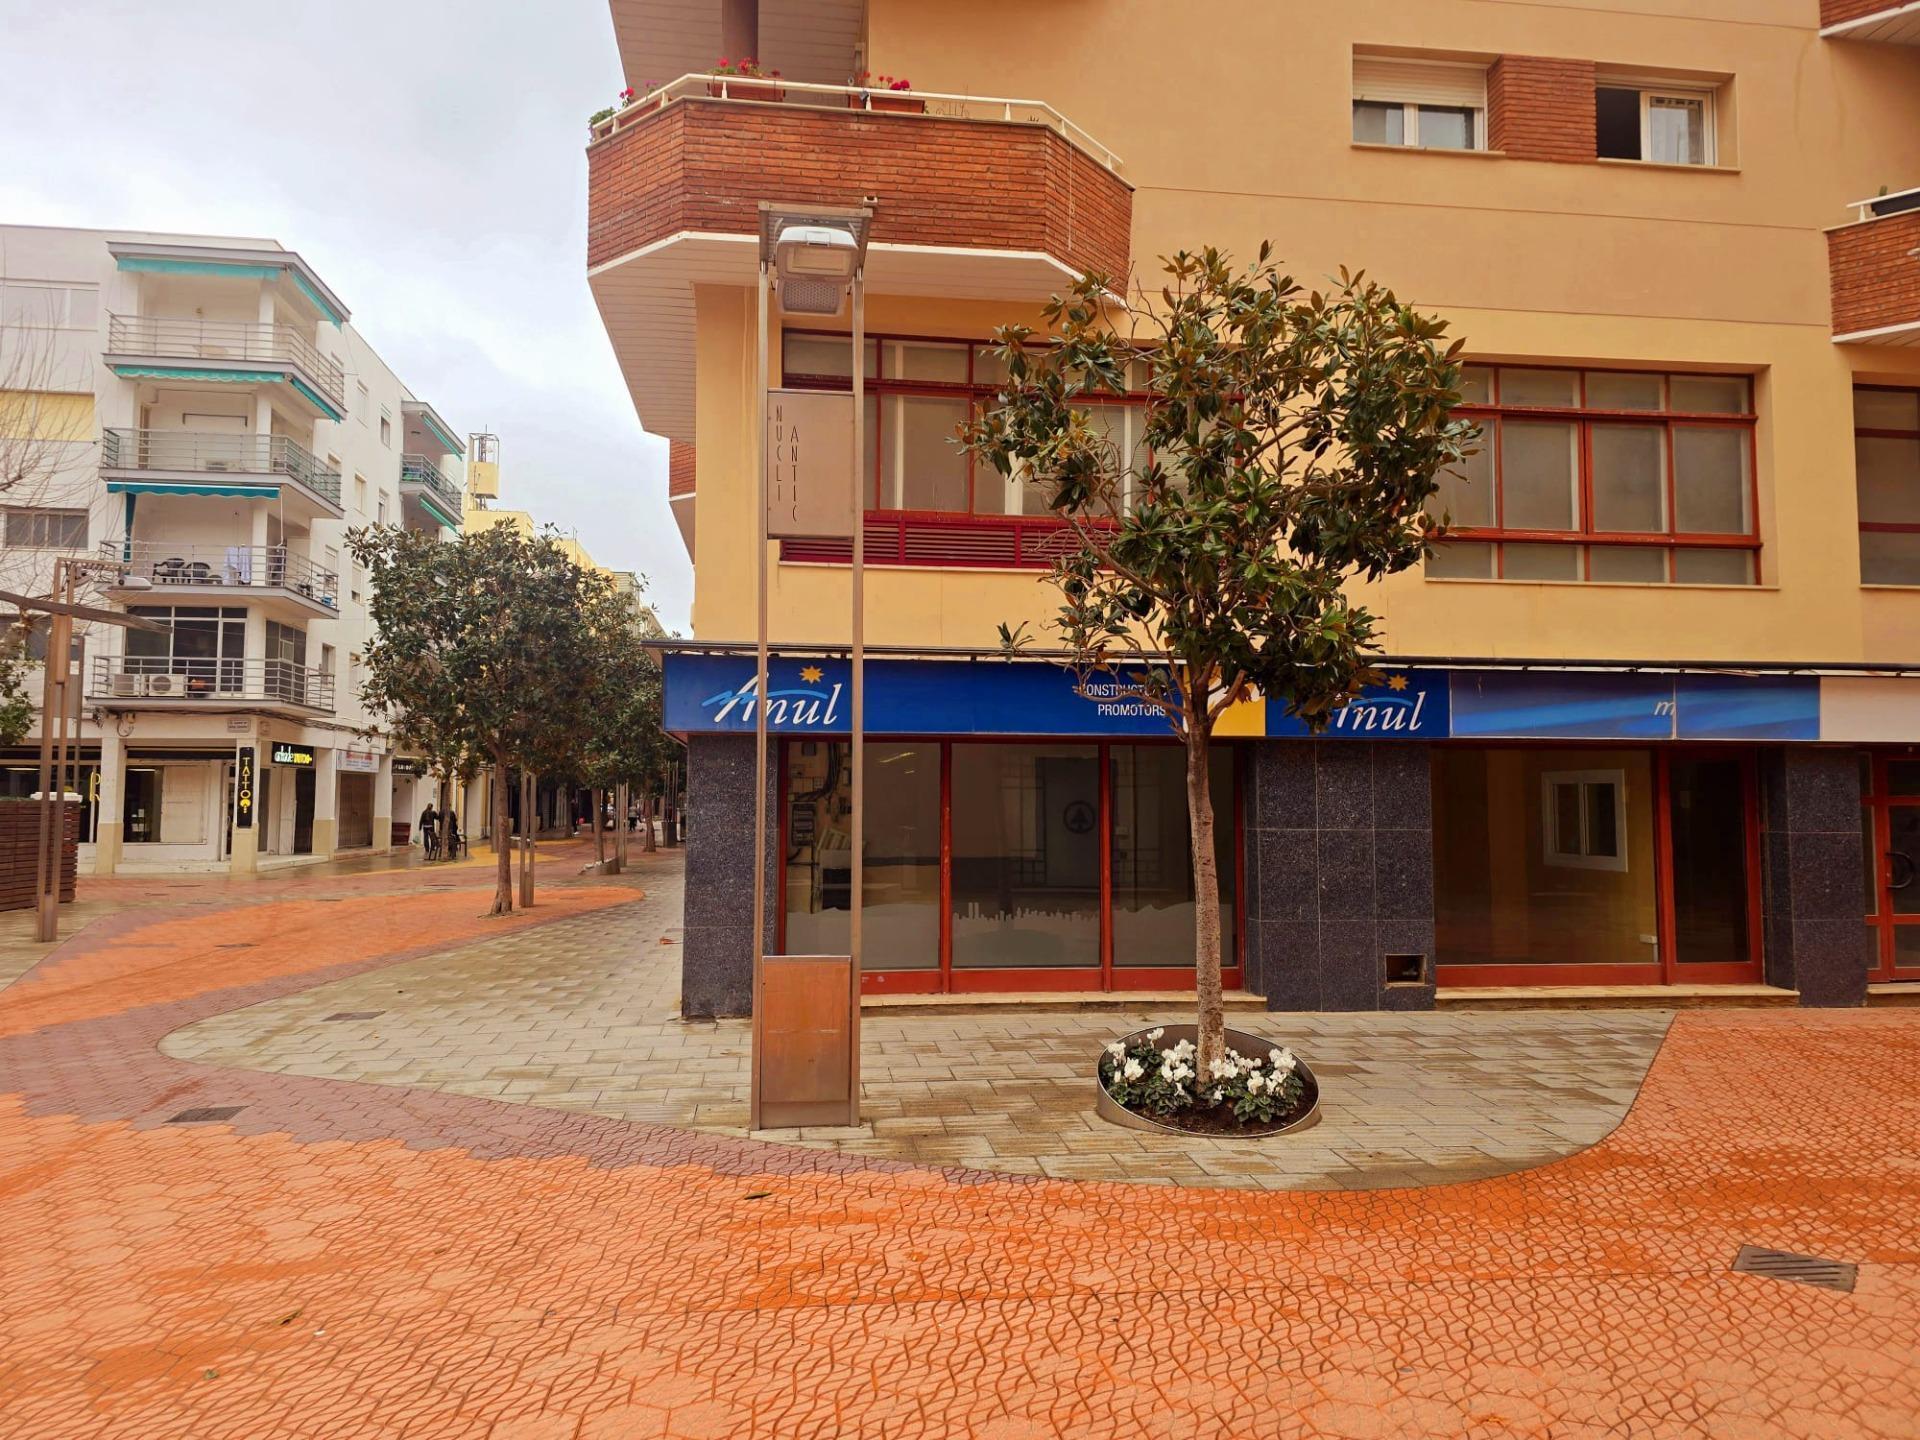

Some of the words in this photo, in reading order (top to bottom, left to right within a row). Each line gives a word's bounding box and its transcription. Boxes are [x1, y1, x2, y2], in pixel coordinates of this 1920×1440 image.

[775, 404, 784, 503] NUCLI
[790, 425, 800, 523] ANTIC
[713, 671, 843, 725] Anul
